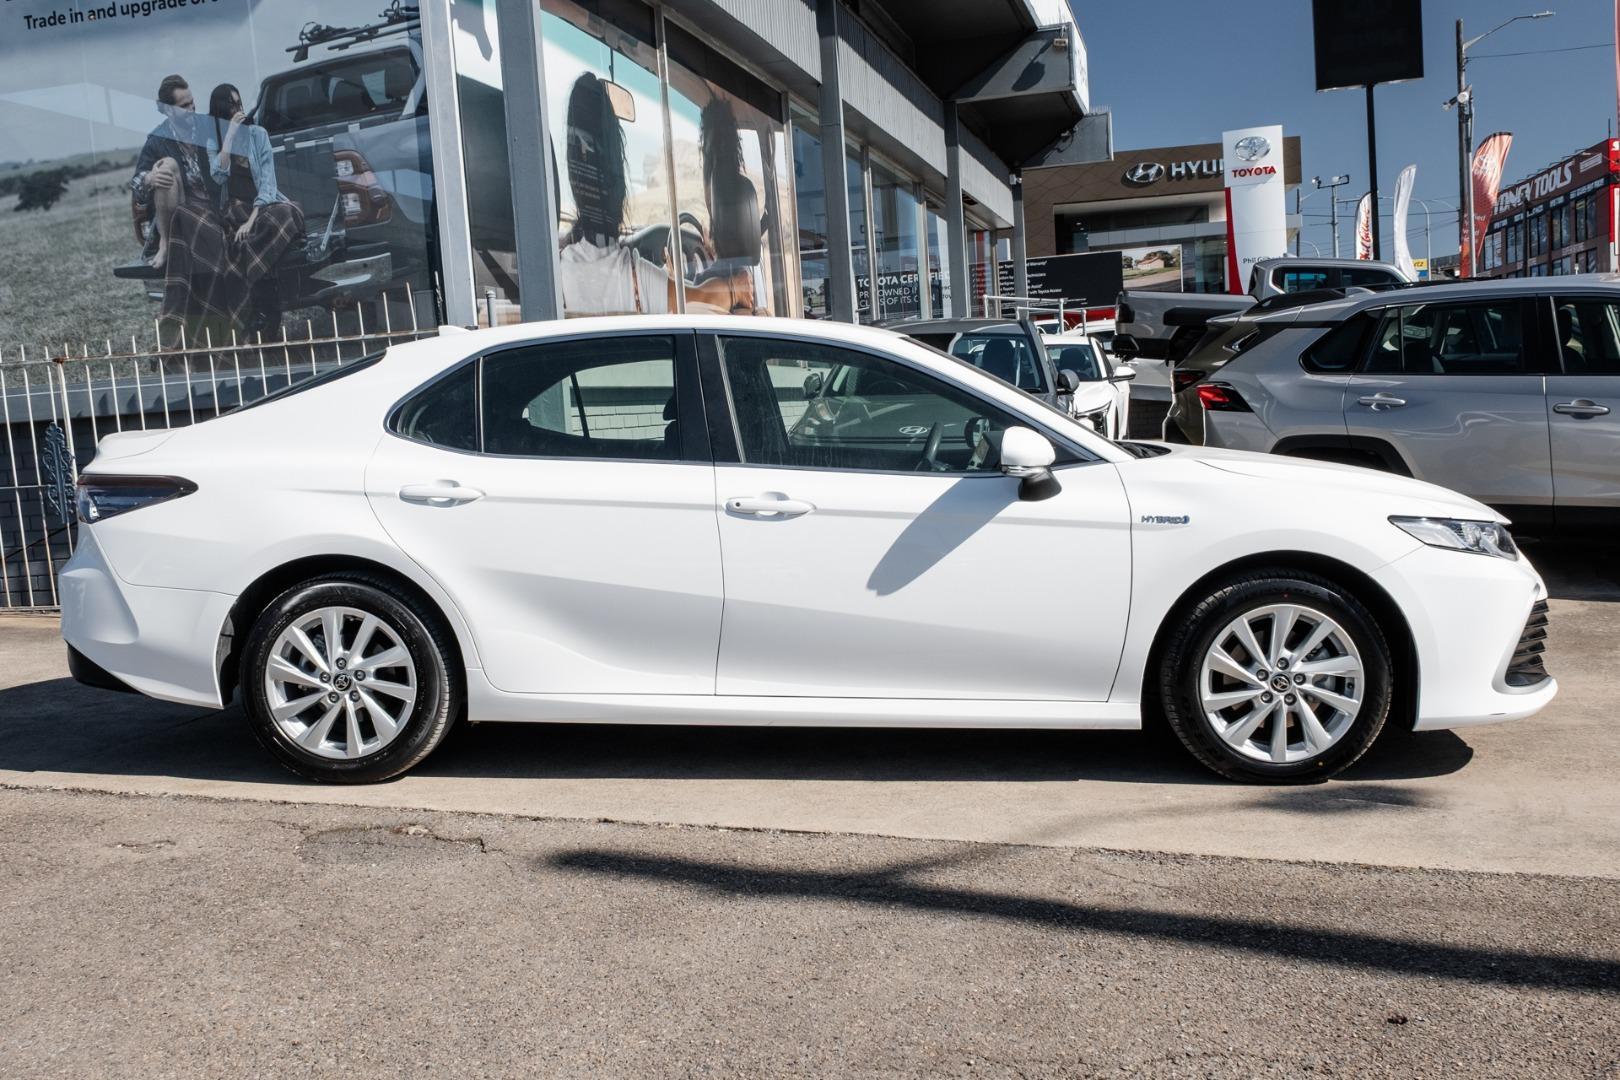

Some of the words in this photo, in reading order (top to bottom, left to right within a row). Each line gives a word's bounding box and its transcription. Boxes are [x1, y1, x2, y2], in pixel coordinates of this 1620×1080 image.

[24, 11, 66, 30] Trade
[69, 8, 84, 23] in
[87, 1, 117, 21] and
[120, 0, 187, 18] upgrade
[1232, 166, 1276, 178] TOYOTA
[1534, 160, 1575, 199] TOOLS
[858, 276, 898, 287] TOOTA
[886, 297, 897, 305] OF
[900, 295, 912, 304] ITS
[1141, 515, 1184, 524] HYBRID
